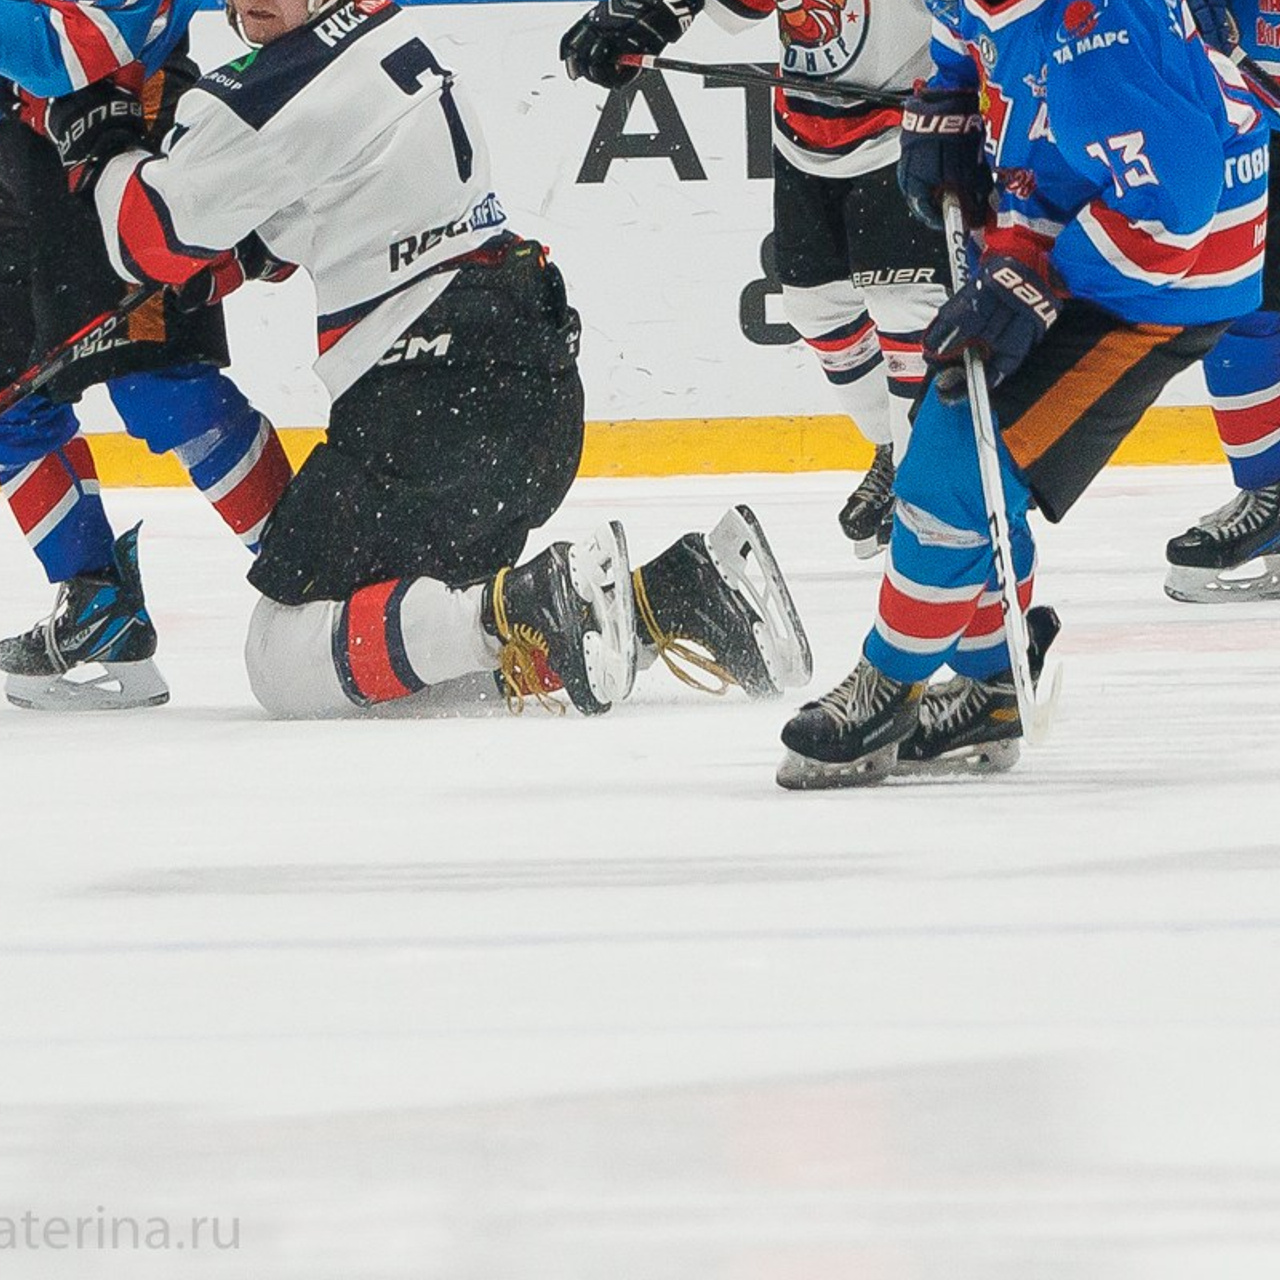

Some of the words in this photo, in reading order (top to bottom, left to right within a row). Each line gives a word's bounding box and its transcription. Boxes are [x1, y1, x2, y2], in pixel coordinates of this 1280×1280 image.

[1076, 29, 1130, 55] МАРС
[380, 37, 474, 184] 7
[1085, 130, 1160, 199] 13
[852, 267, 936, 288] BAUER
